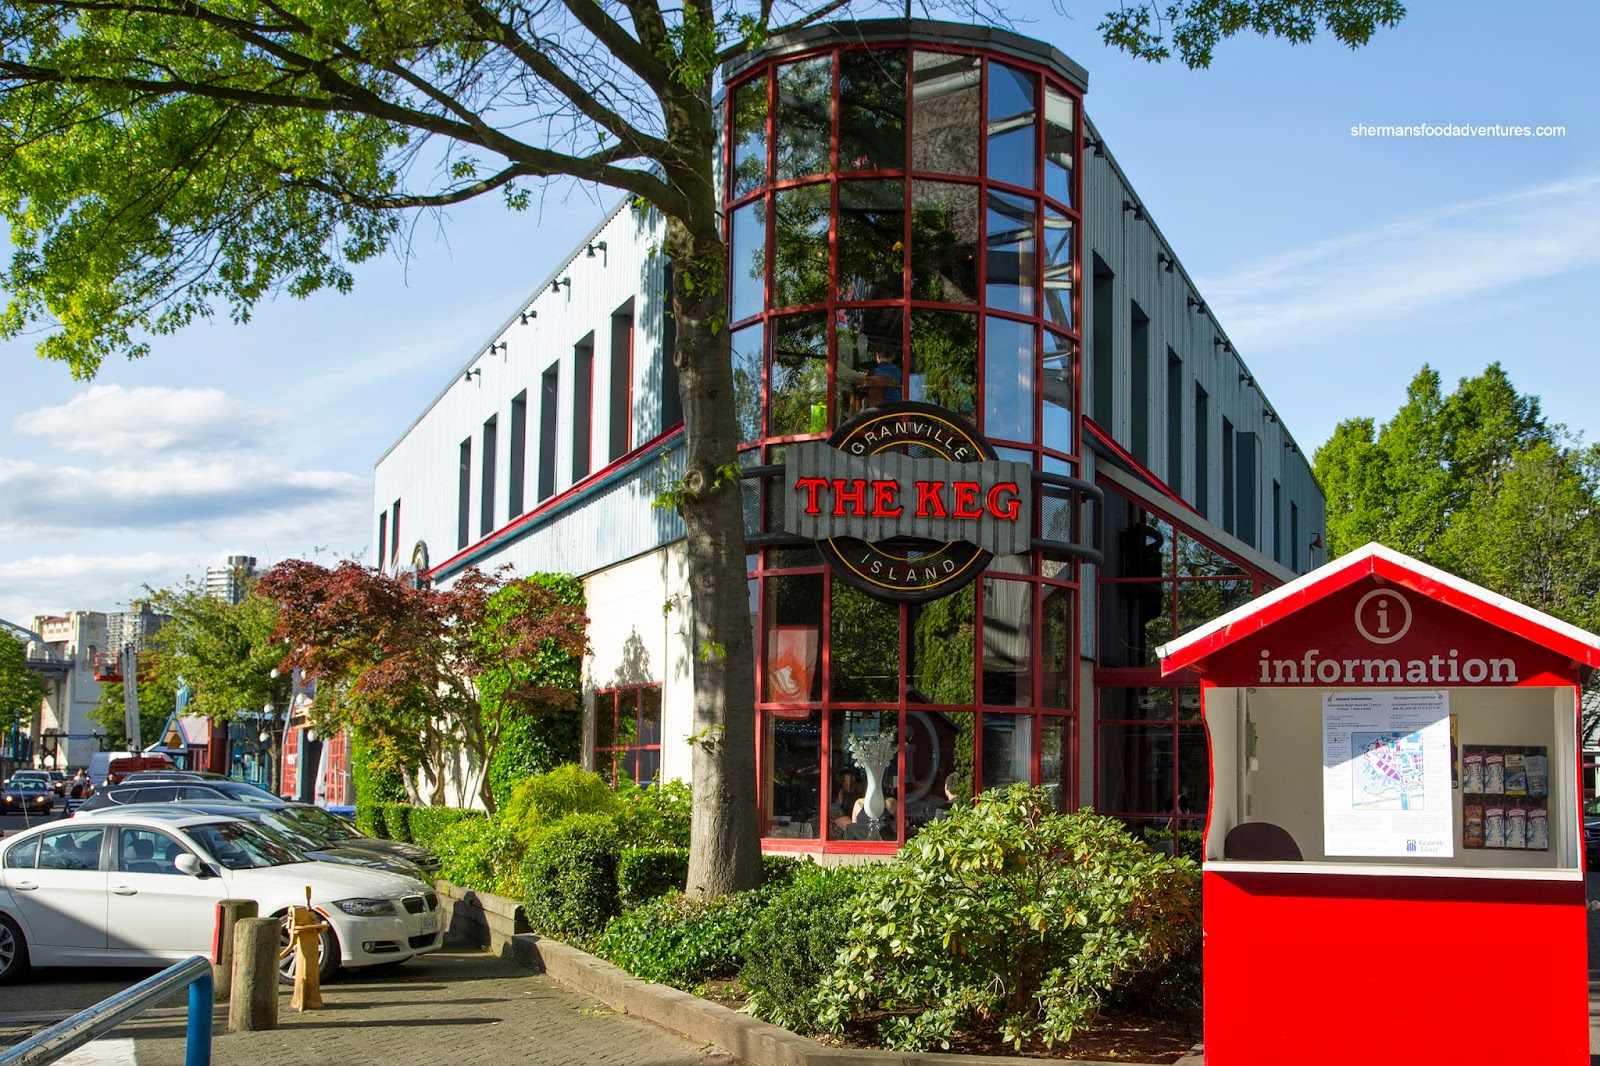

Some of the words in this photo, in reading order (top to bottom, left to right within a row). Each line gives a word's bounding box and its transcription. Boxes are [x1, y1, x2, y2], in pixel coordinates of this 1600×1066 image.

[851, 421, 968, 461] GRANVILLE
[795, 477, 903, 519] THE
[915, 481, 1022, 521] KEG
[861, 553, 955, 581] ISLAND
[1258, 648, 1519, 684] information
